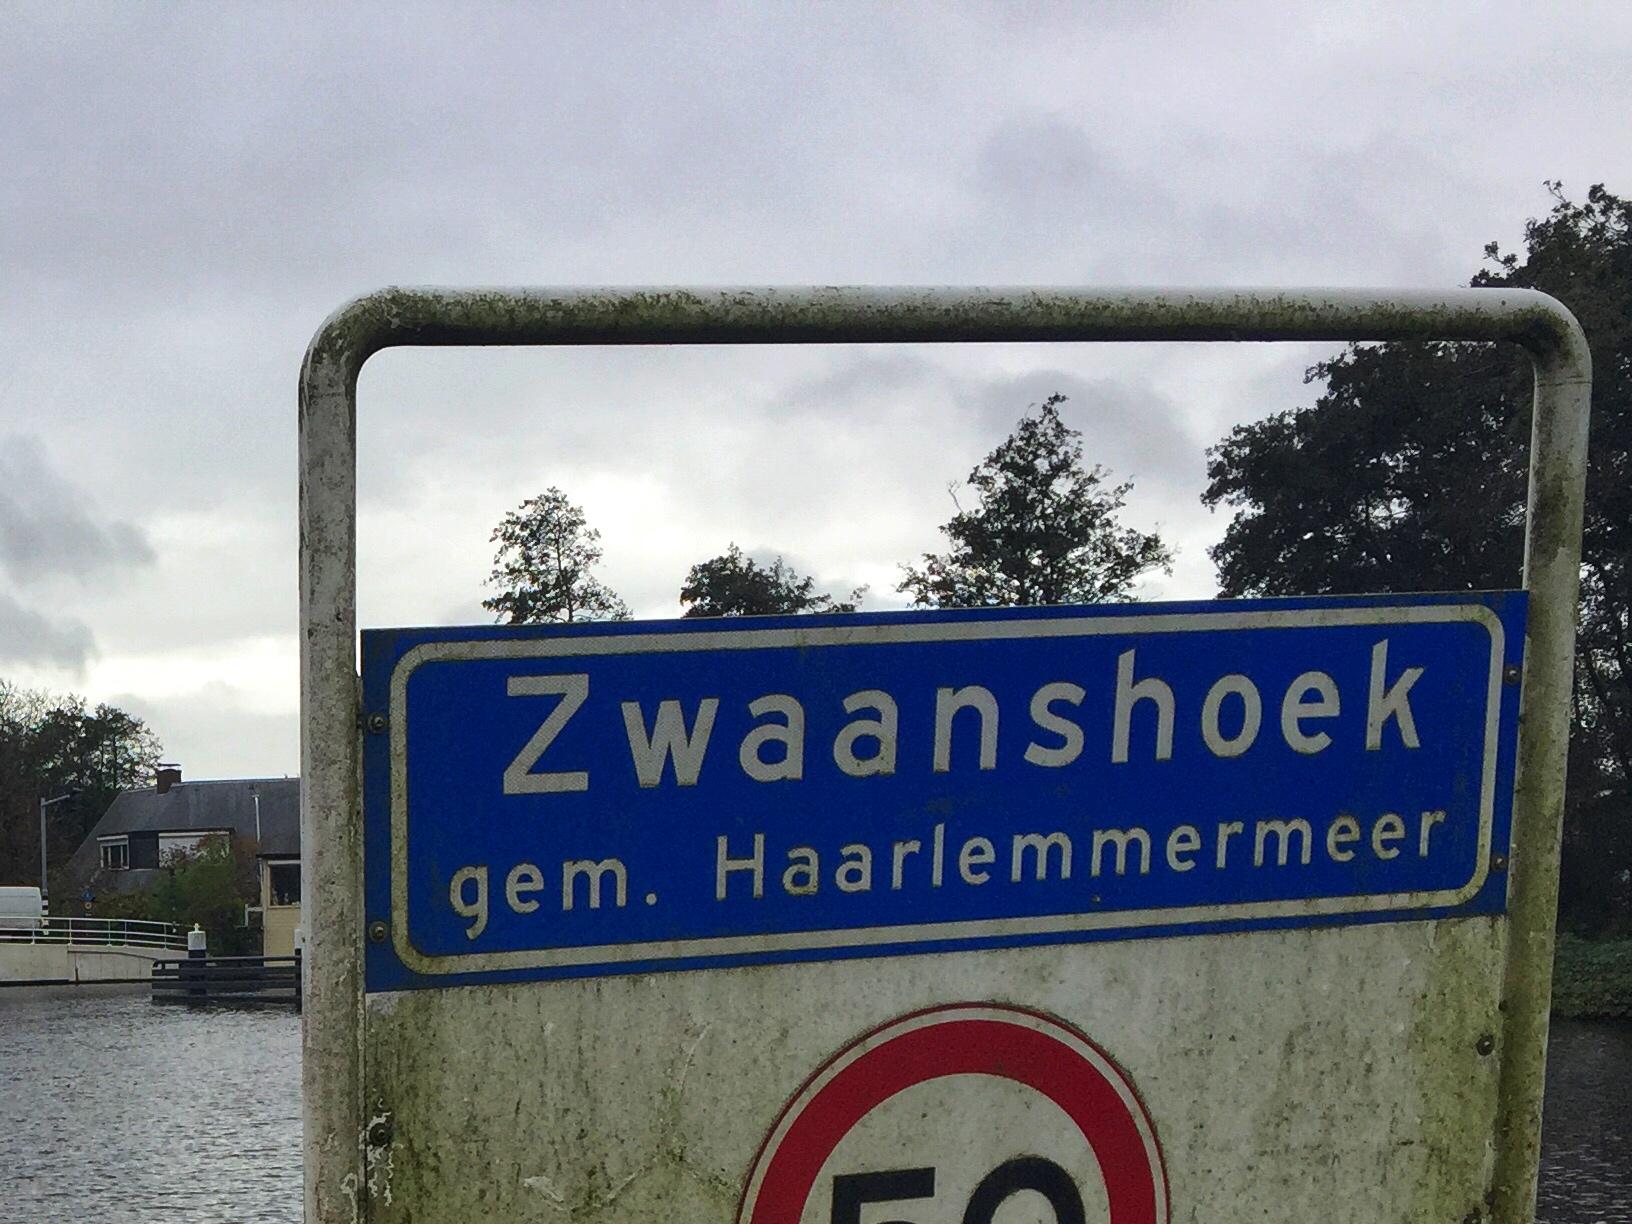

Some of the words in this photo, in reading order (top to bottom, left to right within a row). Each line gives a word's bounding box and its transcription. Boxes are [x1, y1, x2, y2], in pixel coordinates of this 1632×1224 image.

[501, 640, 1425, 796] Zwaanshoek
[447, 852, 659, 941] gem.
[714, 808, 1447, 901] Haarlemmermeer
